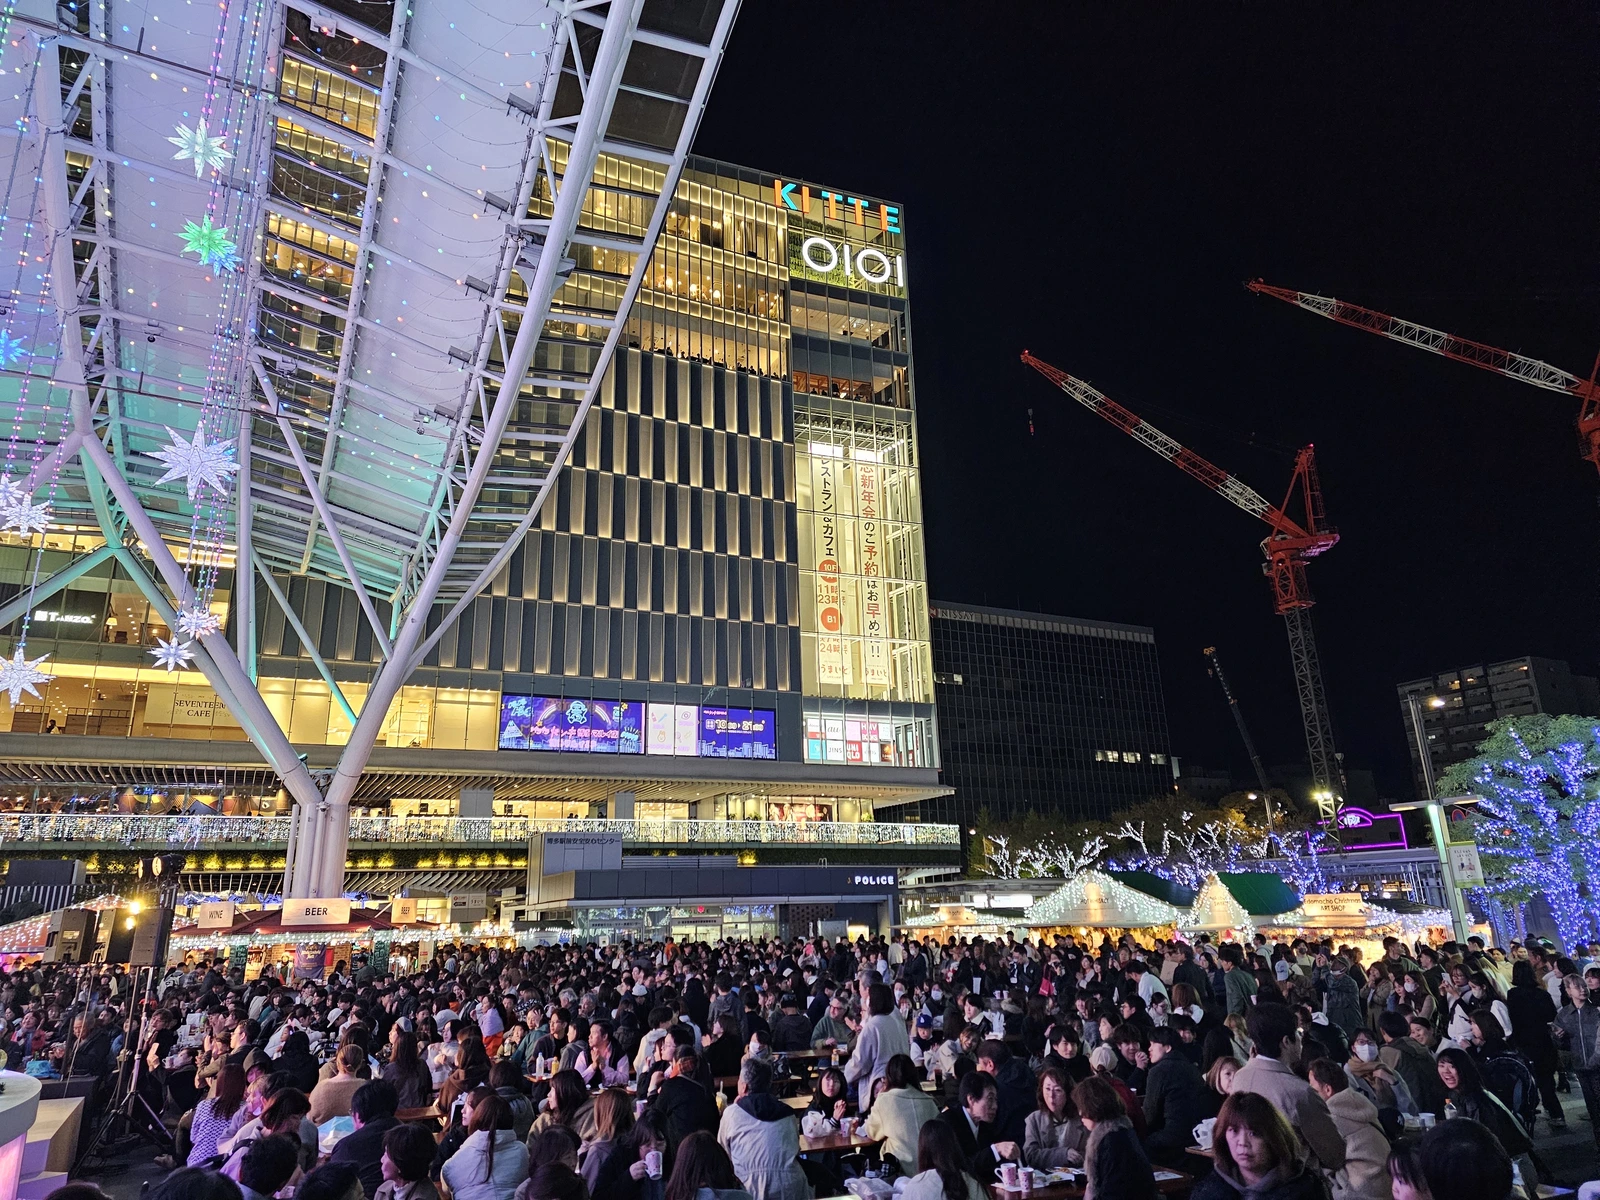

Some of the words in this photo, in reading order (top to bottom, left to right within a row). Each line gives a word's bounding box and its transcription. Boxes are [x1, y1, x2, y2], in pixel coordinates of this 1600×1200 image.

[774, 179, 901, 234] KITTE
[827, 615, 837, 624] B1
[941, 610, 974, 620] NISSAY
[175, 700, 226, 709] SEVENTEEN
[187, 709, 211, 717] CAFE
[854, 875, 895, 885] POLICE
[208, 910, 223, 919] WINE
[305, 907, 328, 916] BEER
